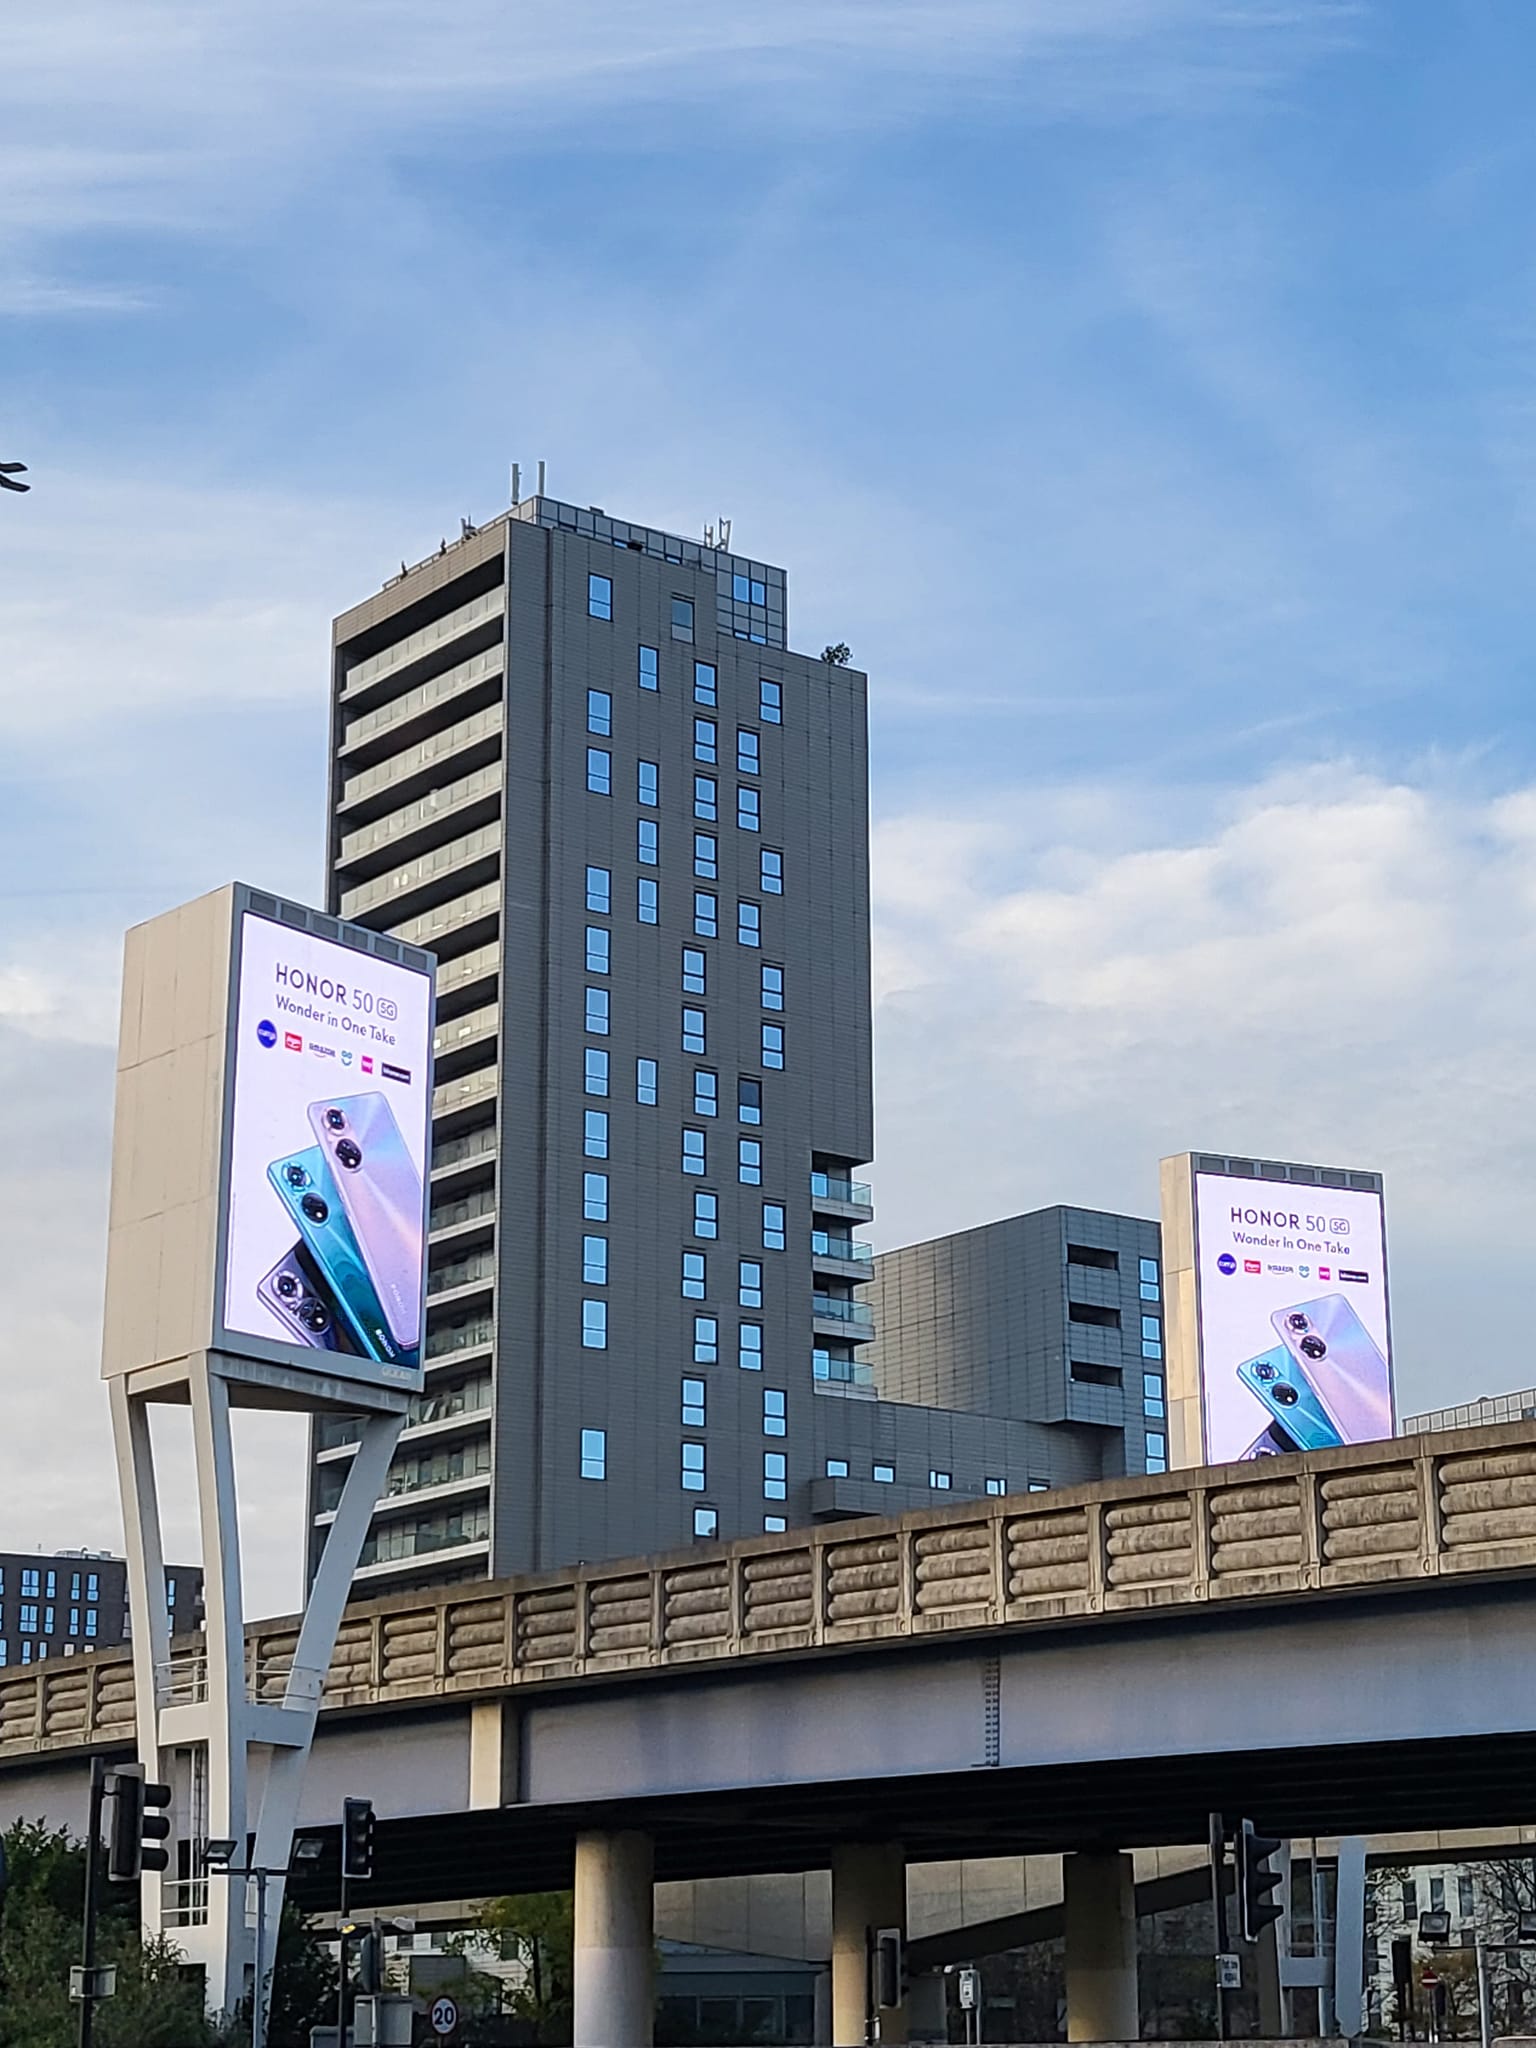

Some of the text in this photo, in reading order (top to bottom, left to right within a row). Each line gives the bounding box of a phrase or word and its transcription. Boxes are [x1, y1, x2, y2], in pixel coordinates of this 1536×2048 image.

[276, 963, 347, 1005] HONOR
[352, 989, 373, 1013] 50
[276, 994, 396, 1045] Wonder in One Take
[1231, 1207, 1300, 1229] HONOR
[1306, 1215, 1326, 1232] 50
[1232, 1231, 1280, 1247] Wonder
[1296, 1239, 1321, 1252] One
[1323, 1241, 1350, 1254] Take
[434, 2006, 454, 2025] 20
